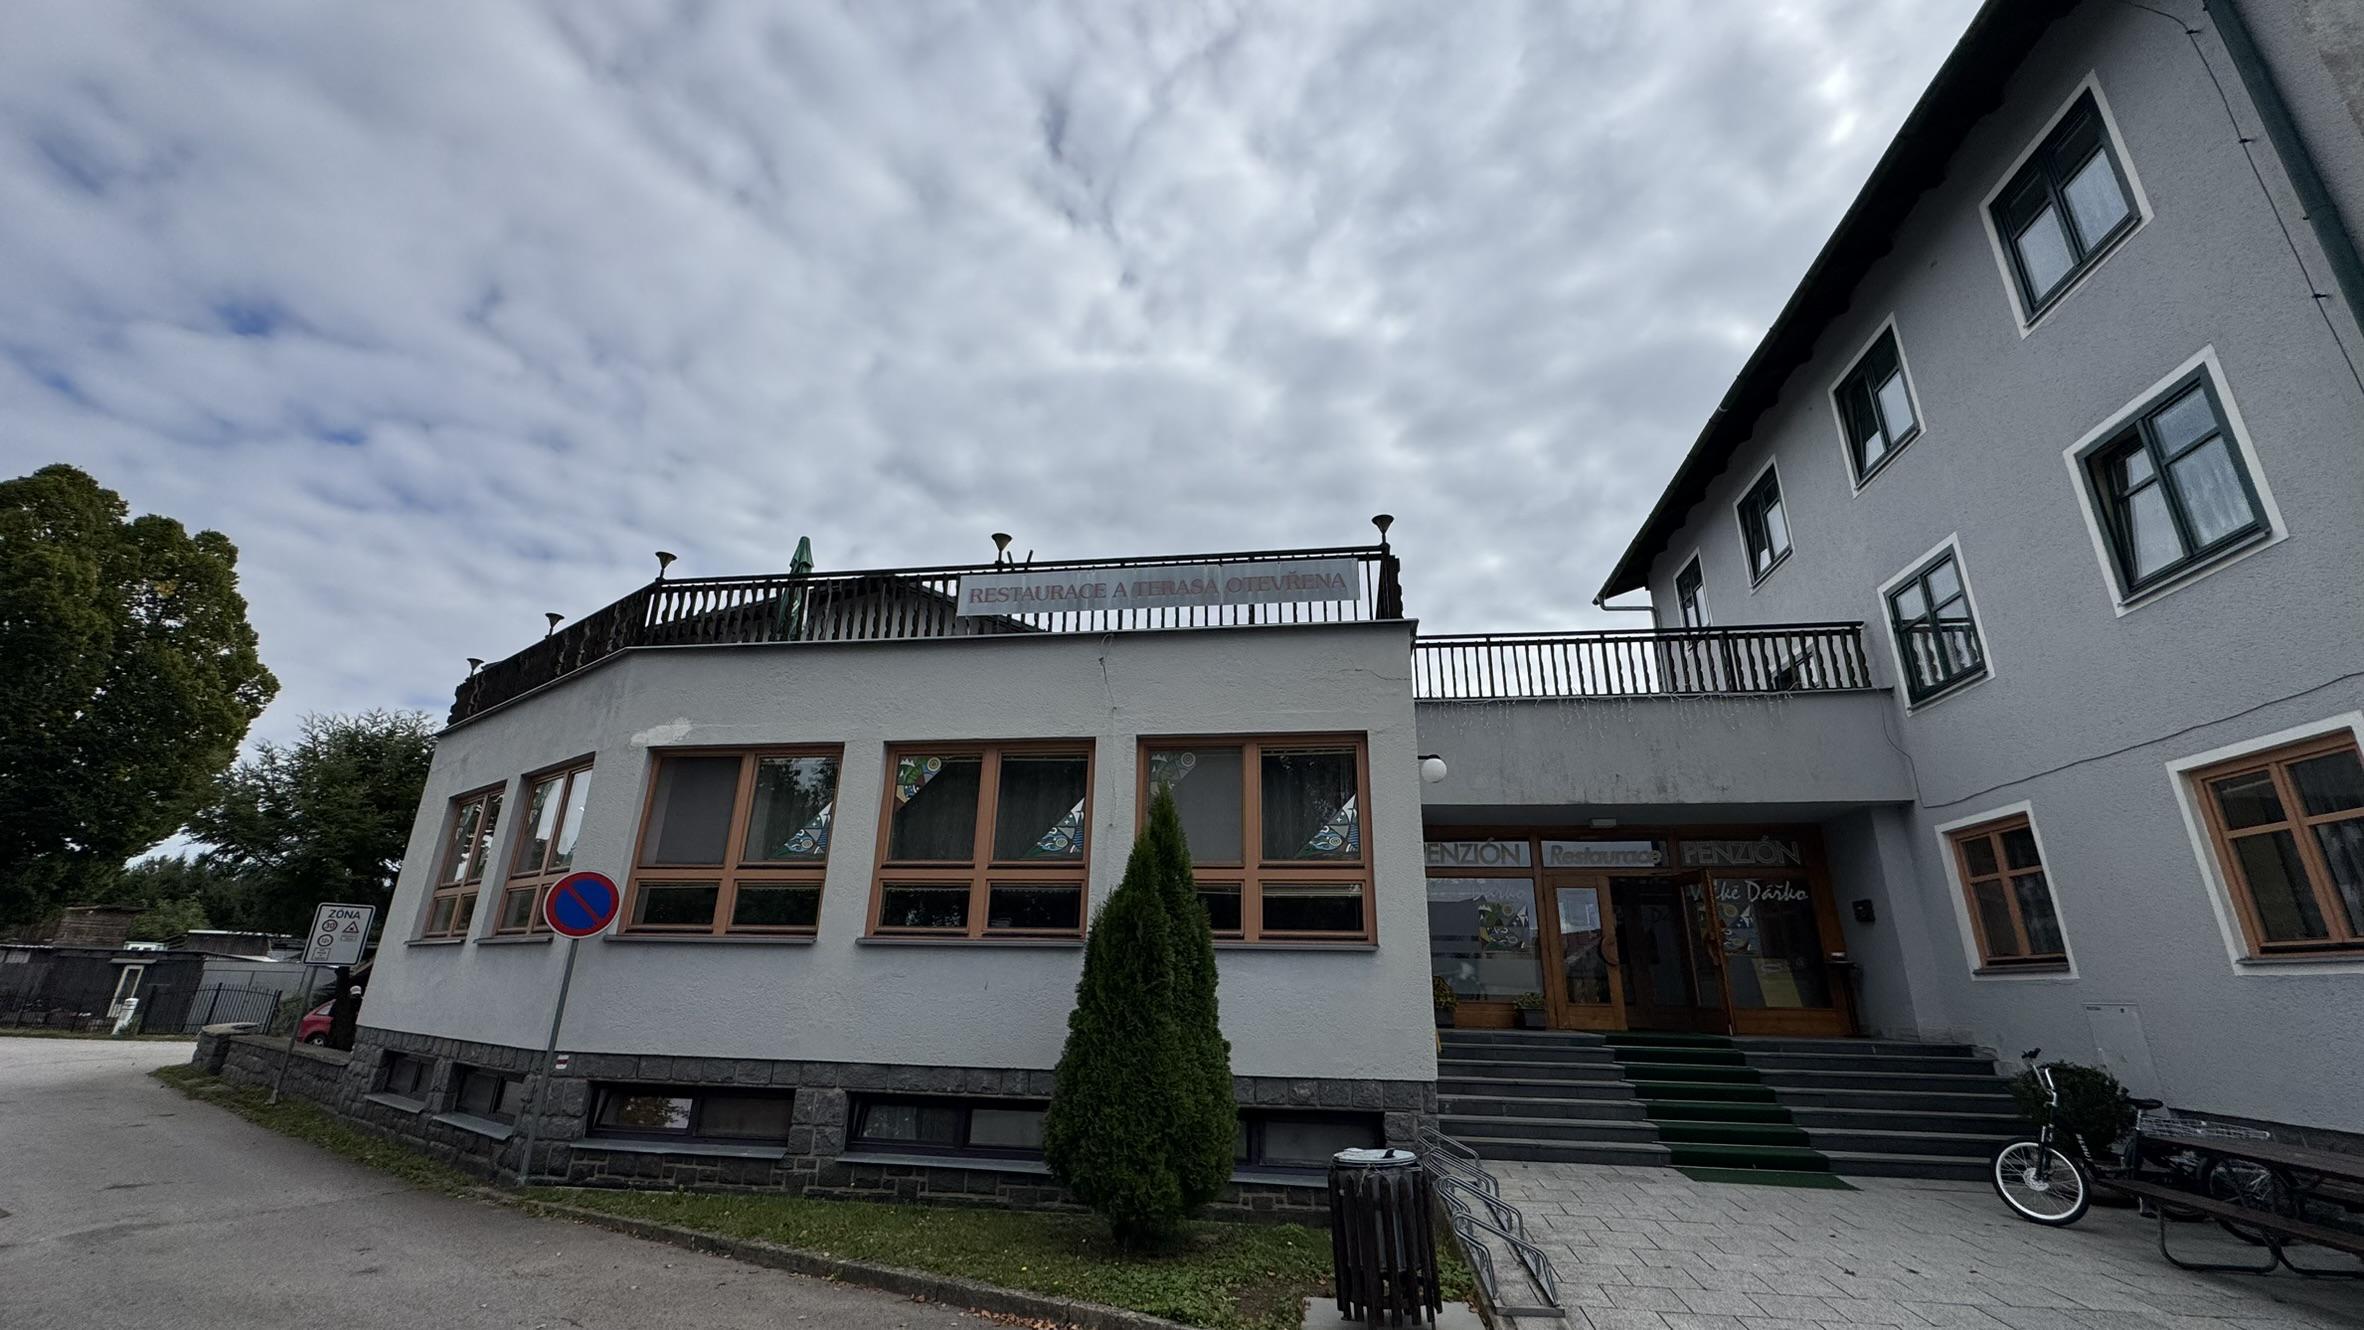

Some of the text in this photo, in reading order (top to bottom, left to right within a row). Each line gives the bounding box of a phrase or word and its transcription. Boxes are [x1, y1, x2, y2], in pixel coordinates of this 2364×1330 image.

[969, 571, 1346, 604] RESTAURACE A TERASA OTEVŘENA
[1424, 837, 1521, 865] ENZIÓN
[1550, 844, 1663, 865] Restaurace
[1683, 835, 1801, 865] PENZIÓN
[1744, 880, 1809, 903] Dářko
